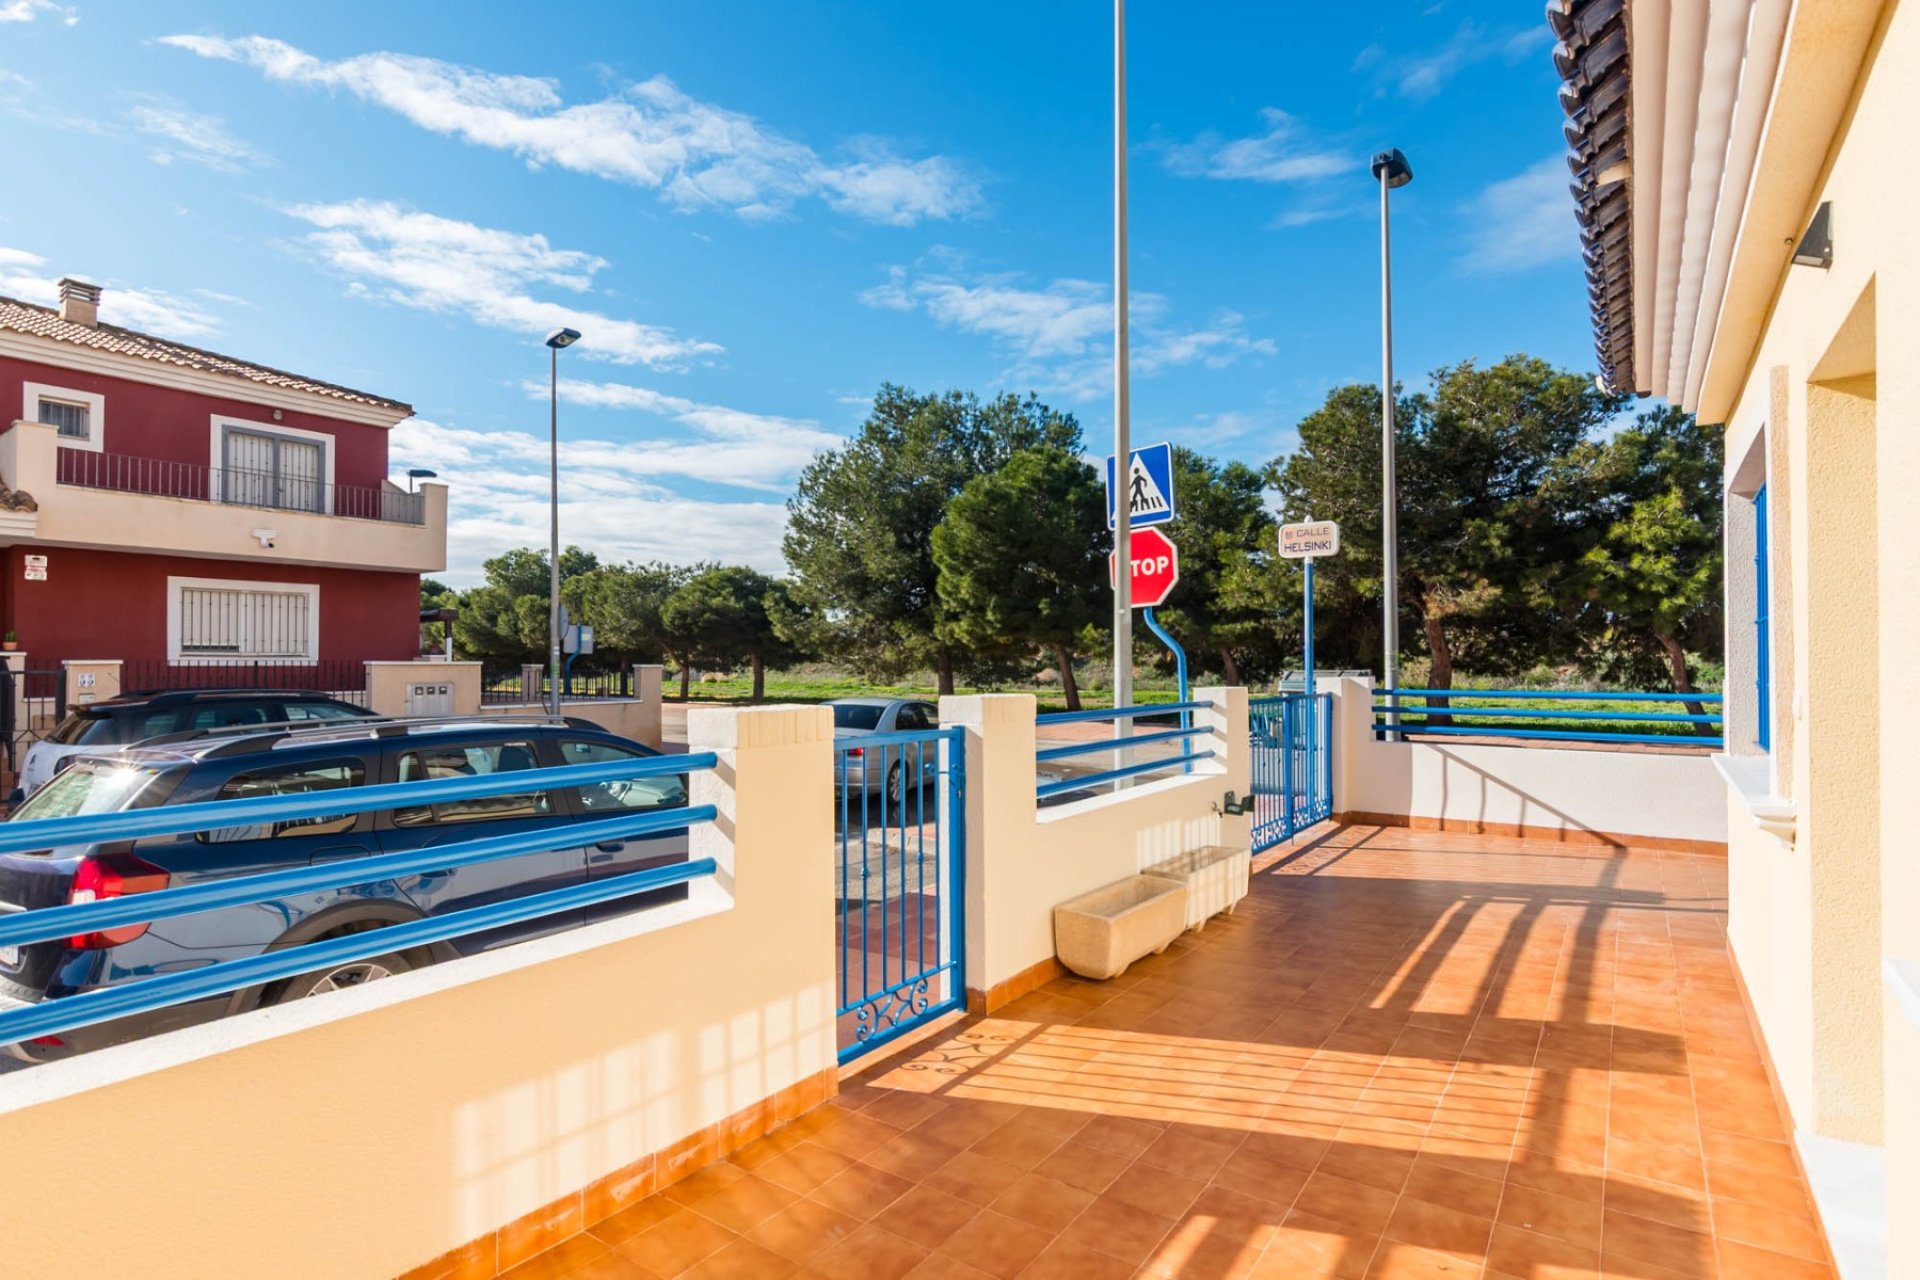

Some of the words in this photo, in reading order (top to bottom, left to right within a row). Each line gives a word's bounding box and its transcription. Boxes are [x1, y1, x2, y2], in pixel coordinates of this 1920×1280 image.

[1296, 527, 1329, 537] CALLE
[1284, 541, 1332, 552] HELSINKI
[1130, 555, 1169, 577] TOP
